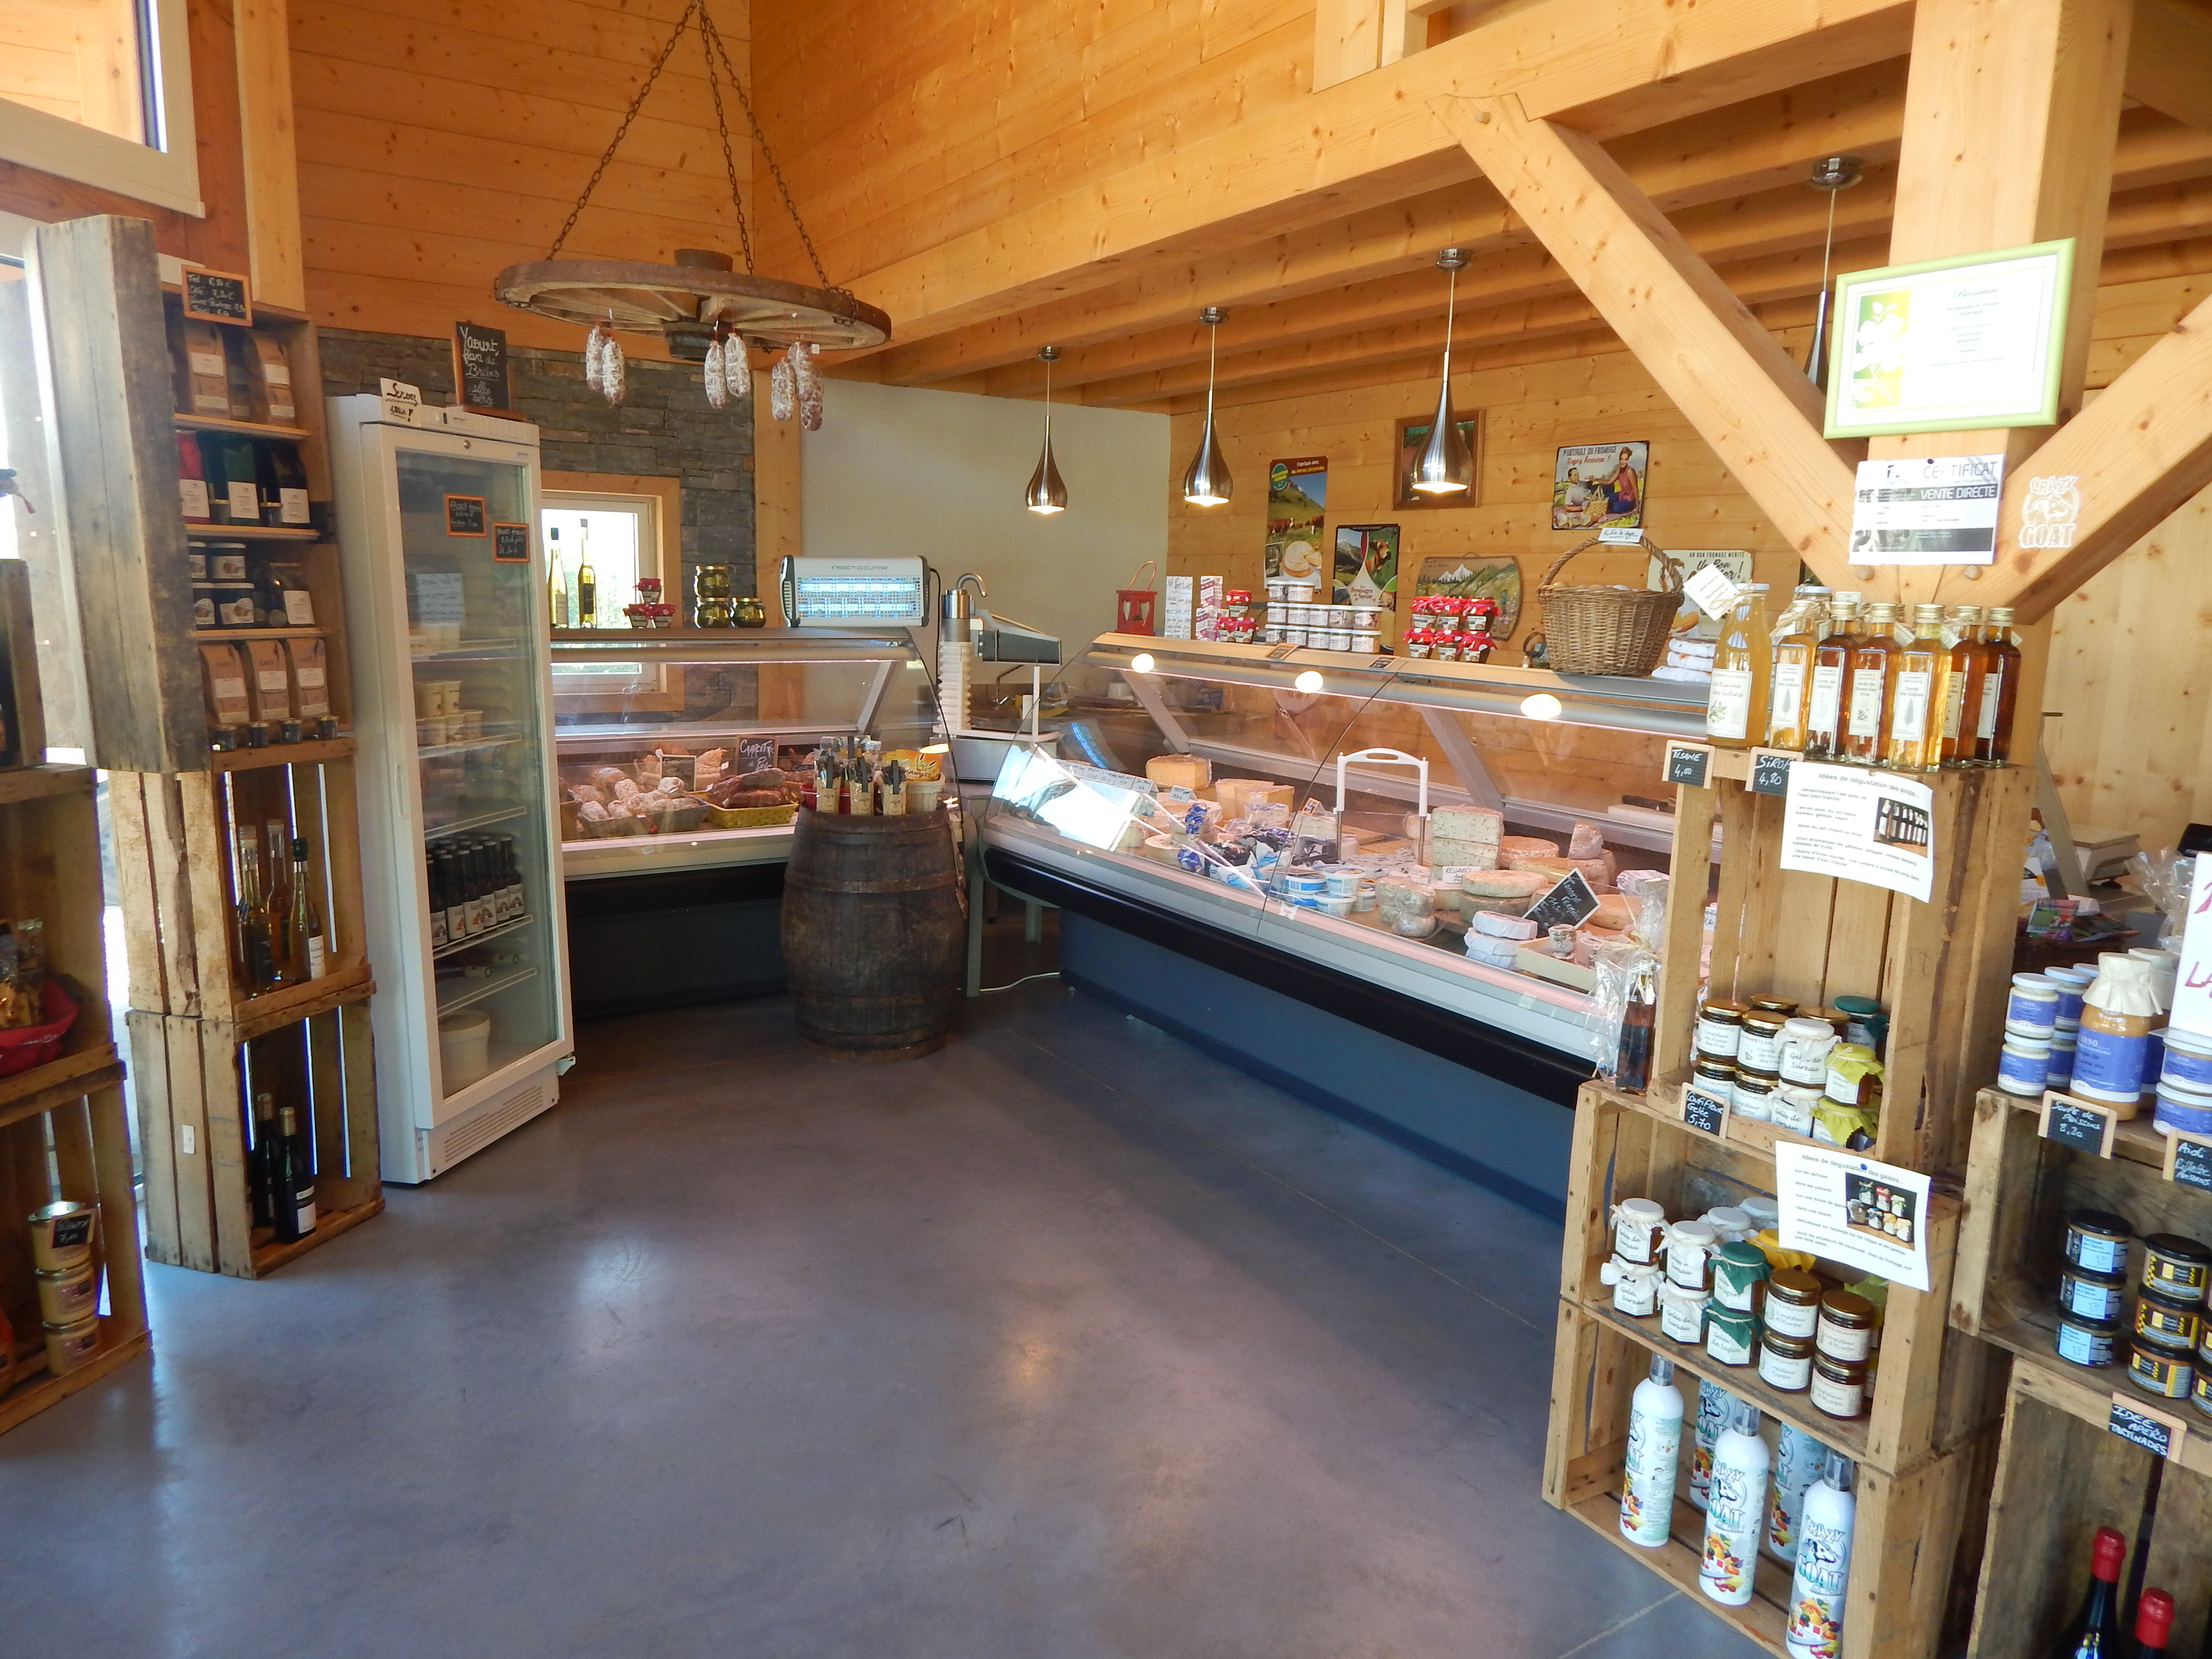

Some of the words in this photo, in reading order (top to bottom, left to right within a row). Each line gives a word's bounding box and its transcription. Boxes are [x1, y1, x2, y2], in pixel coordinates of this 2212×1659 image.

[1595, 445, 1617, 454] FROMAGE
[2030, 476, 2078, 495] CRAZY
[1921, 486, 1953, 500] VENTE
[1956, 485, 1996, 499] DIRECTE
[2019, 524, 2076, 549] GOAT
[1351, 587, 1373, 595] Fromages
[1671, 749, 1702, 761] TISANE
[1791, 1062, 1820, 1071] Sureau
[1622, 1295, 1645, 1305] Sureau
[1804, 1515, 1845, 1543] CRAZY
